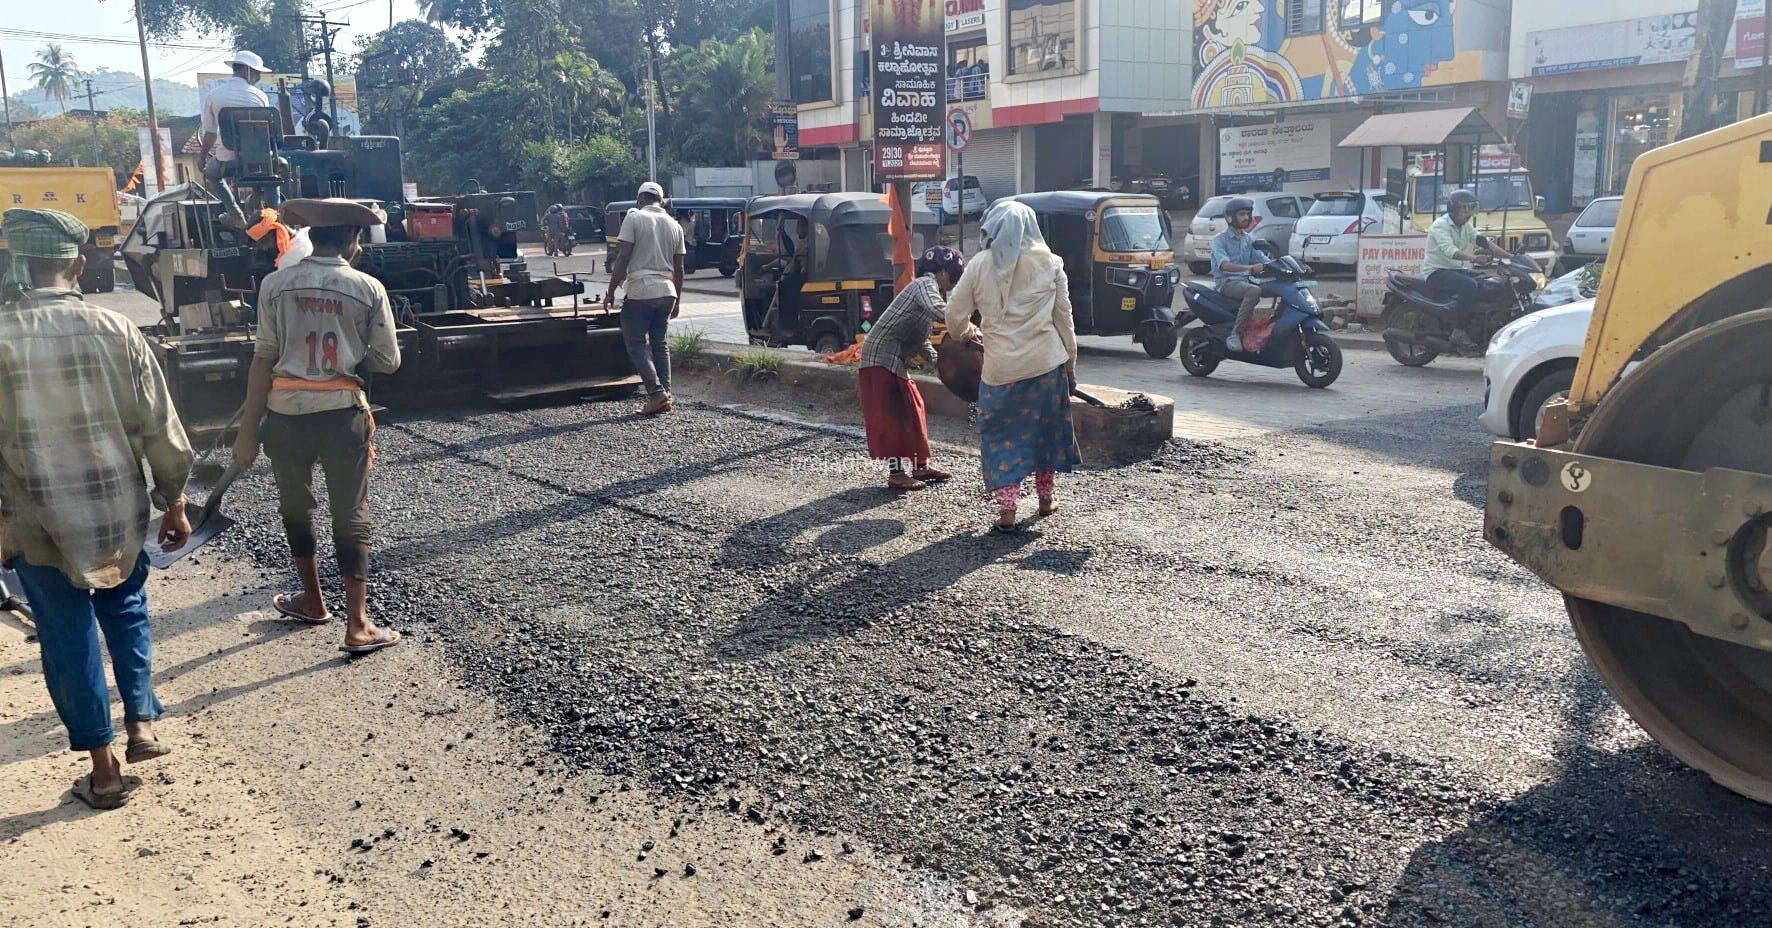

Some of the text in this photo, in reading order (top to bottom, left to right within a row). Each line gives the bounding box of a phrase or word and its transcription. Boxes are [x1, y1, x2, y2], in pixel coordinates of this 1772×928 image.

[961, 16, 981, 26] LASERS
[894, 41, 938, 60] ಶ್ರೀನಿವಾಸ
[895, 79, 936, 89] ಸಾಮೂಹಿಕ
[881, 88, 936, 107] ವಿವಾಹ
[953, 119, 966, 146] P
[13, 193, 86, 204] R K
[1363, 247, 1425, 260] PAY PARKING
[306, 331, 338, 376] 18
